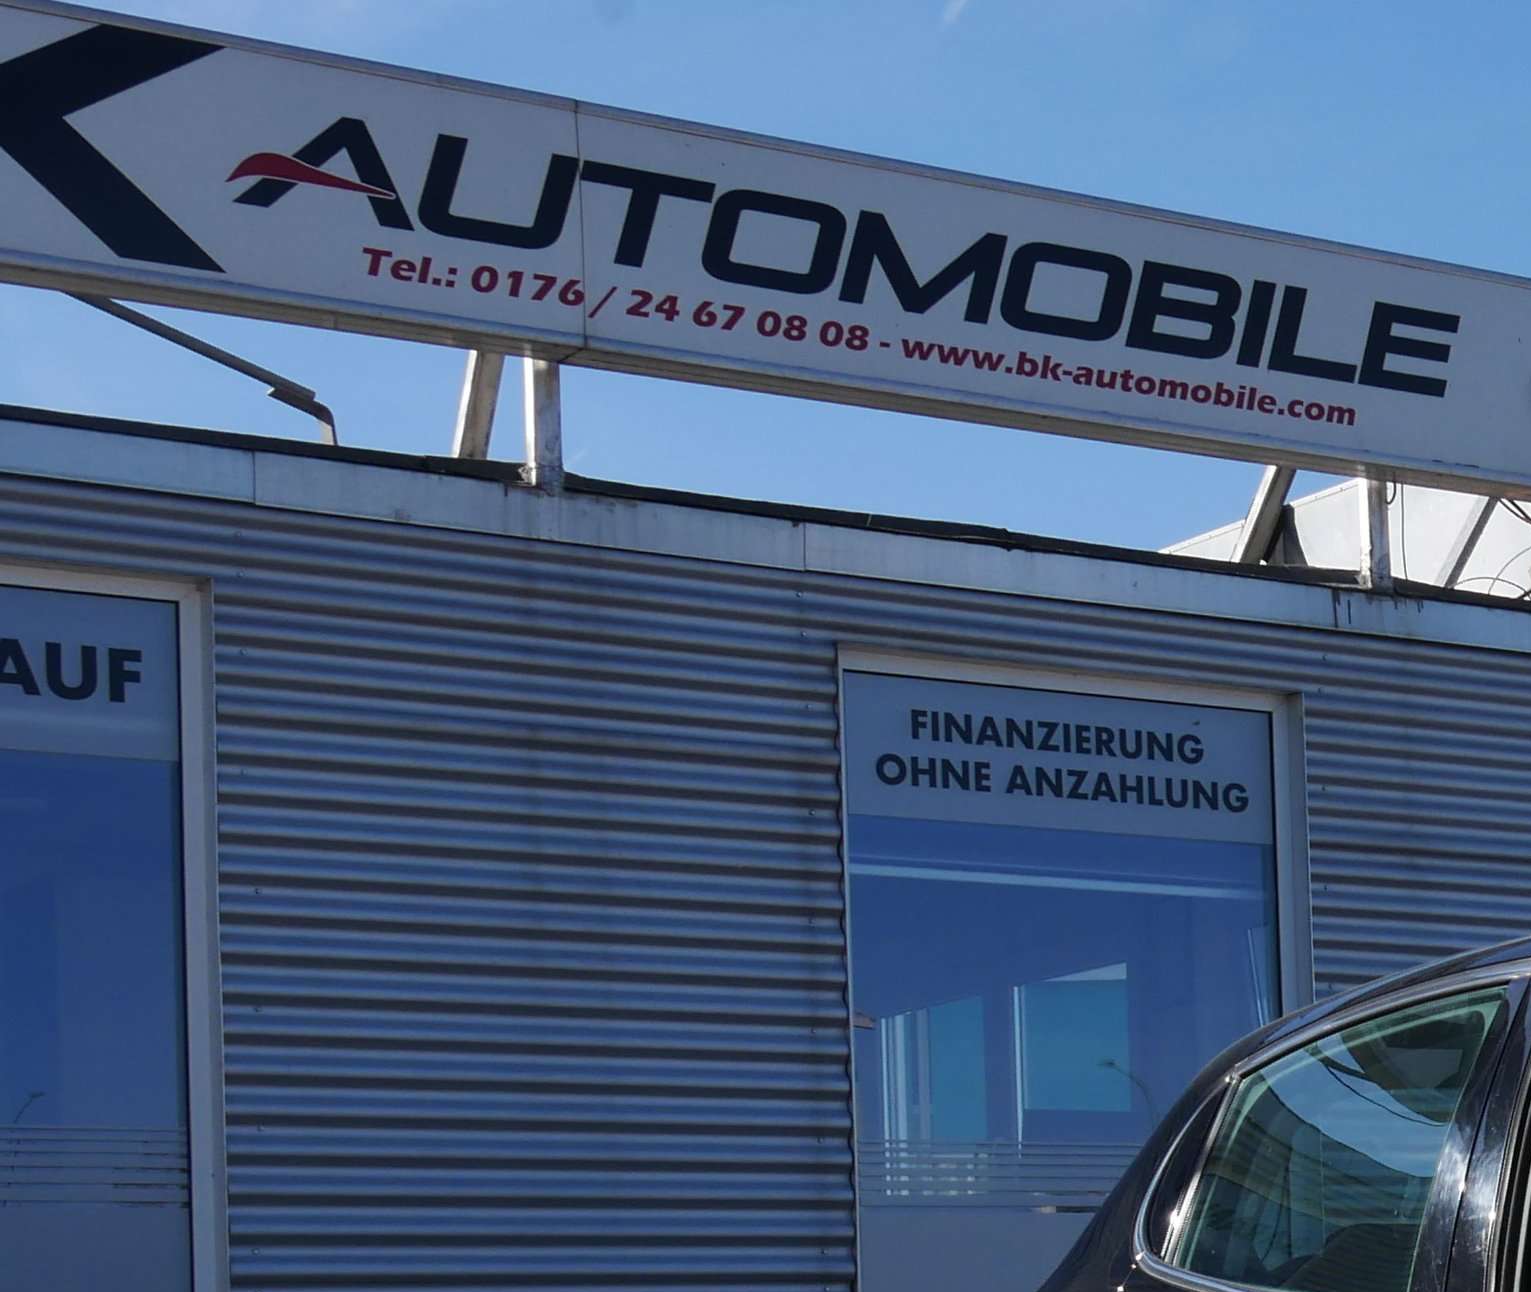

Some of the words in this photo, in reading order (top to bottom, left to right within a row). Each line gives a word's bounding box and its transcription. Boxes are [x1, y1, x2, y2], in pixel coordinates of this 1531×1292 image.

[228, 117, 1461, 398] AUTOMOBILE
[362, 247, 458, 288] Tel.:
[471, 265, 585, 307] 0176
[625, 289, 680, 321] 24
[692, 301, 745, 330] 67
[756, 310, 807, 341] 08
[819, 321, 869, 351] 08
[901, 337, 1357, 426] www.bk-automobile.com
[876, 753, 991, 793] OHNE
[1005, 765, 1249, 813] ANZAHLUNG
[911, 709, 1204, 764] FINANZIERUNG
